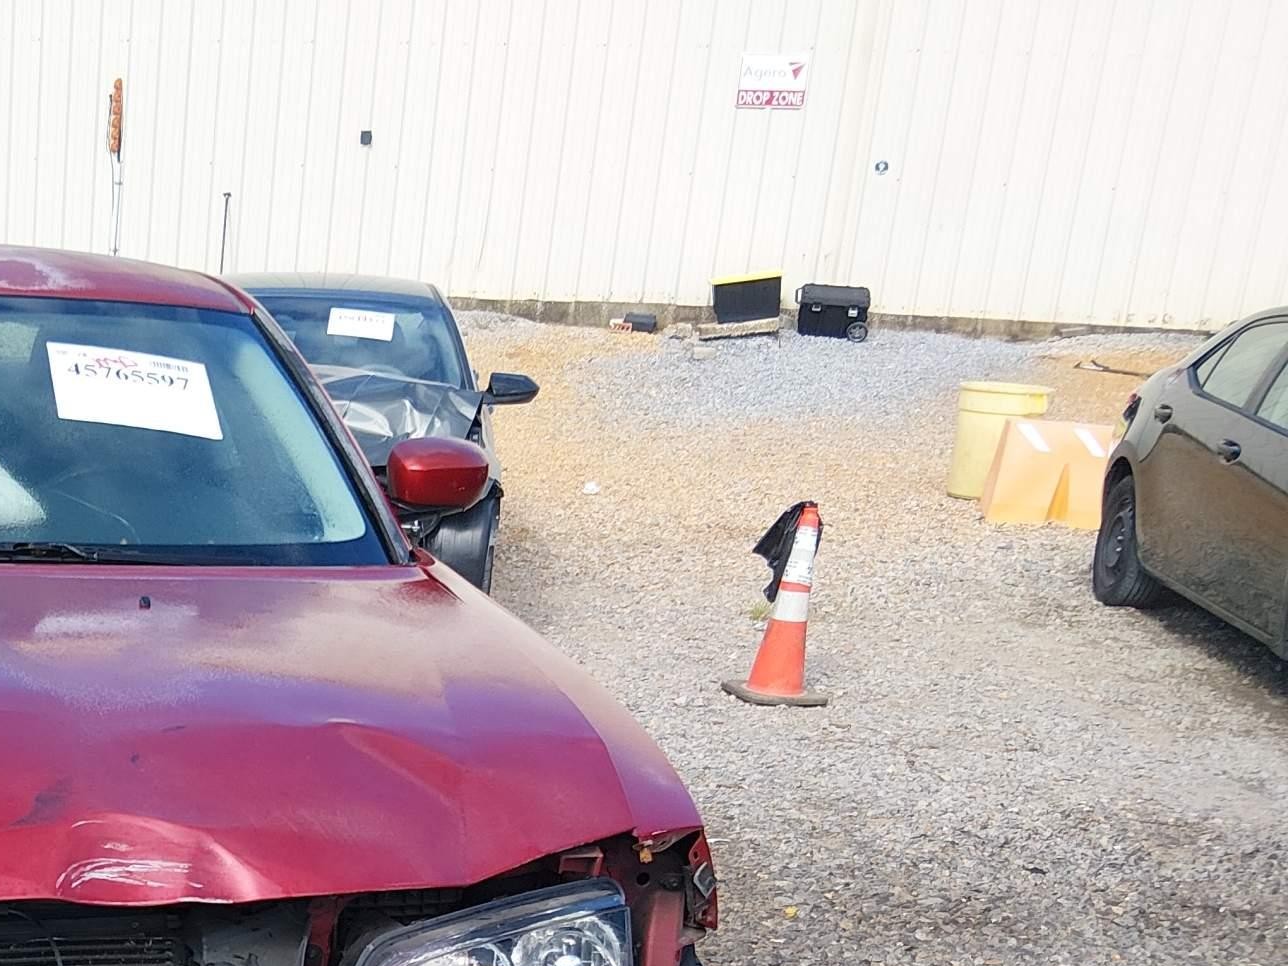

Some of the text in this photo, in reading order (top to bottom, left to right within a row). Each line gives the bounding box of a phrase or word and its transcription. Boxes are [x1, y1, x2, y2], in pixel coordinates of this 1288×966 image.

[738, 91, 804, 106] DROP ZONE
[68, 362, 189, 391] 45765597
